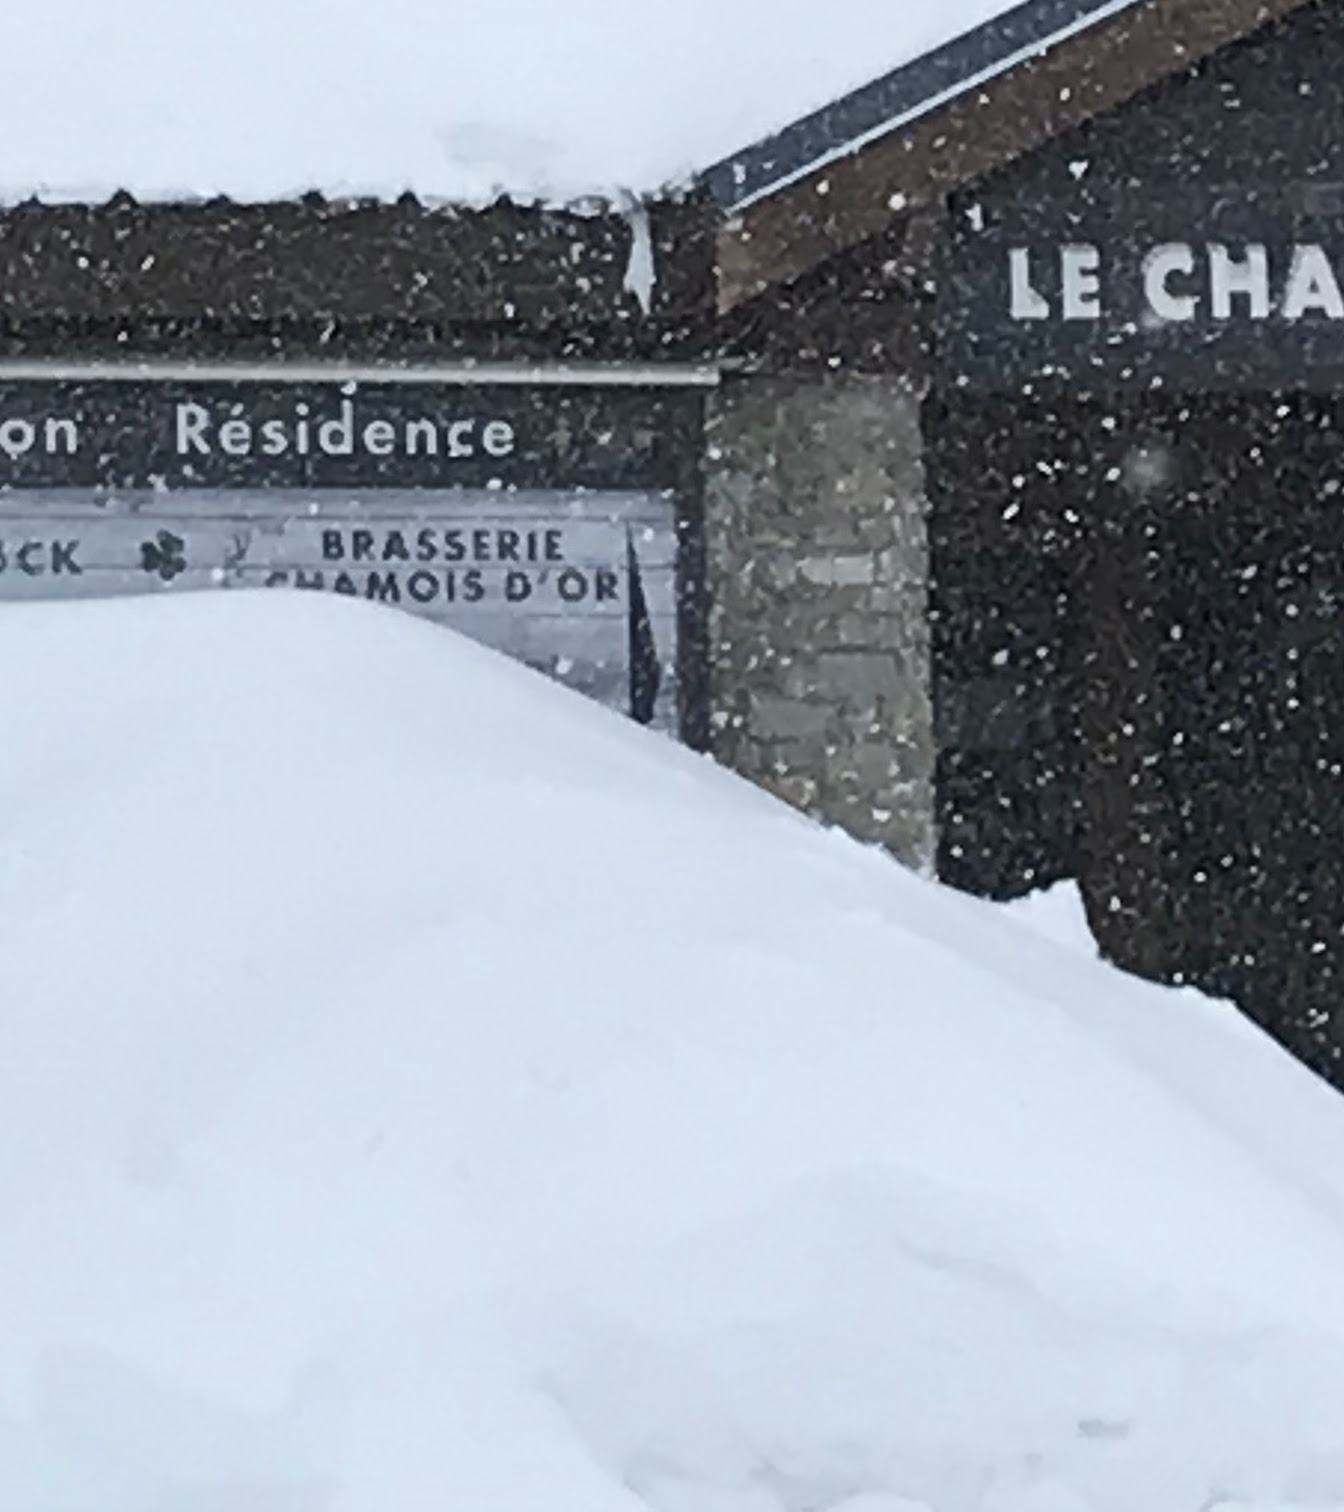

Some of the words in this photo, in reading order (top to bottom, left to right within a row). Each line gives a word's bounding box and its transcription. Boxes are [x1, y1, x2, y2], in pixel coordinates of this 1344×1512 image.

[1009, 245, 1100, 319] LE
[176, 397, 515, 455] Résidence
[322, 530, 564, 560] BRASSERIE
[505, 571, 619, 603] D'OR
